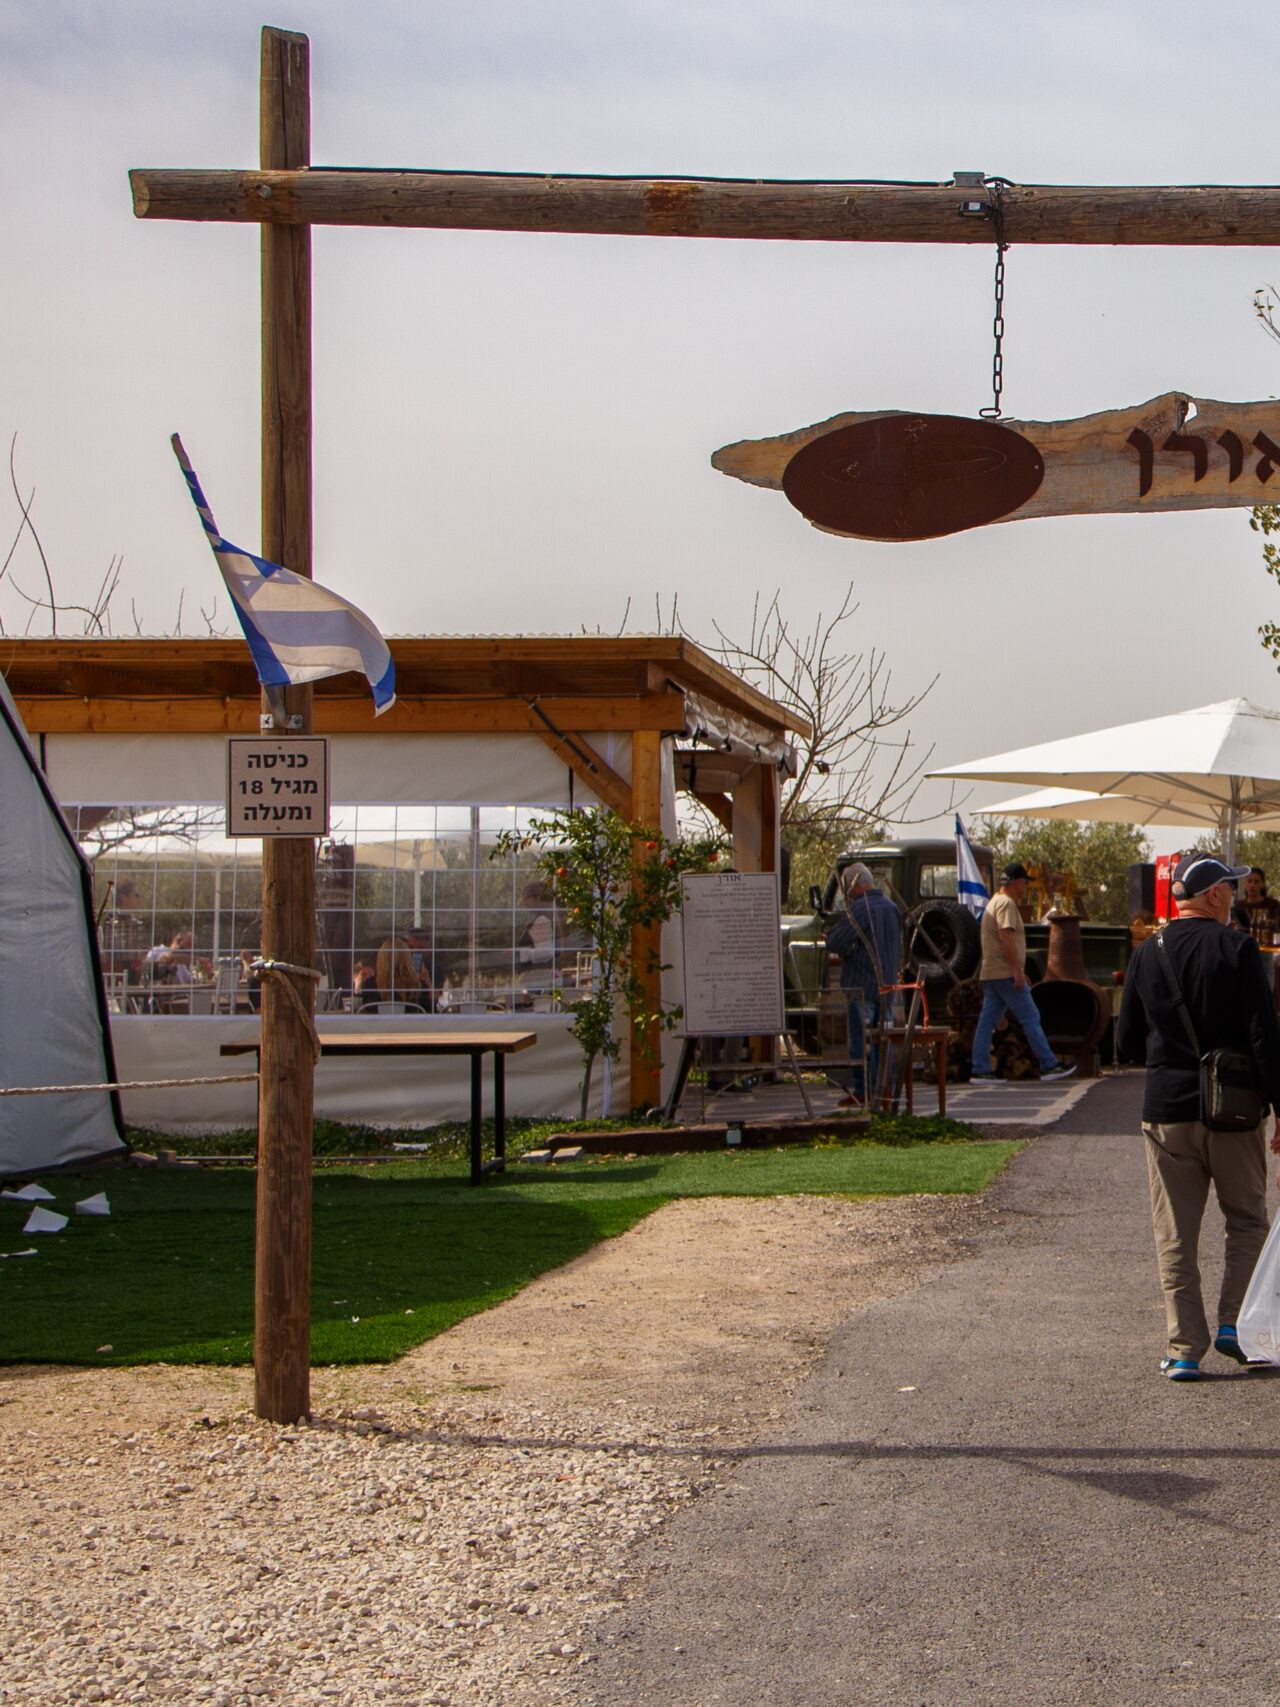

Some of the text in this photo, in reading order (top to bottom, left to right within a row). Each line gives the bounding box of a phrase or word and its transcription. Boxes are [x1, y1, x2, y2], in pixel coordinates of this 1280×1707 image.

[247, 753, 309, 769] כניסה
[238, 776, 318, 795] מגיל 18
[243, 803, 312, 821] ומעלה
[717, 874, 742, 884] אורן
